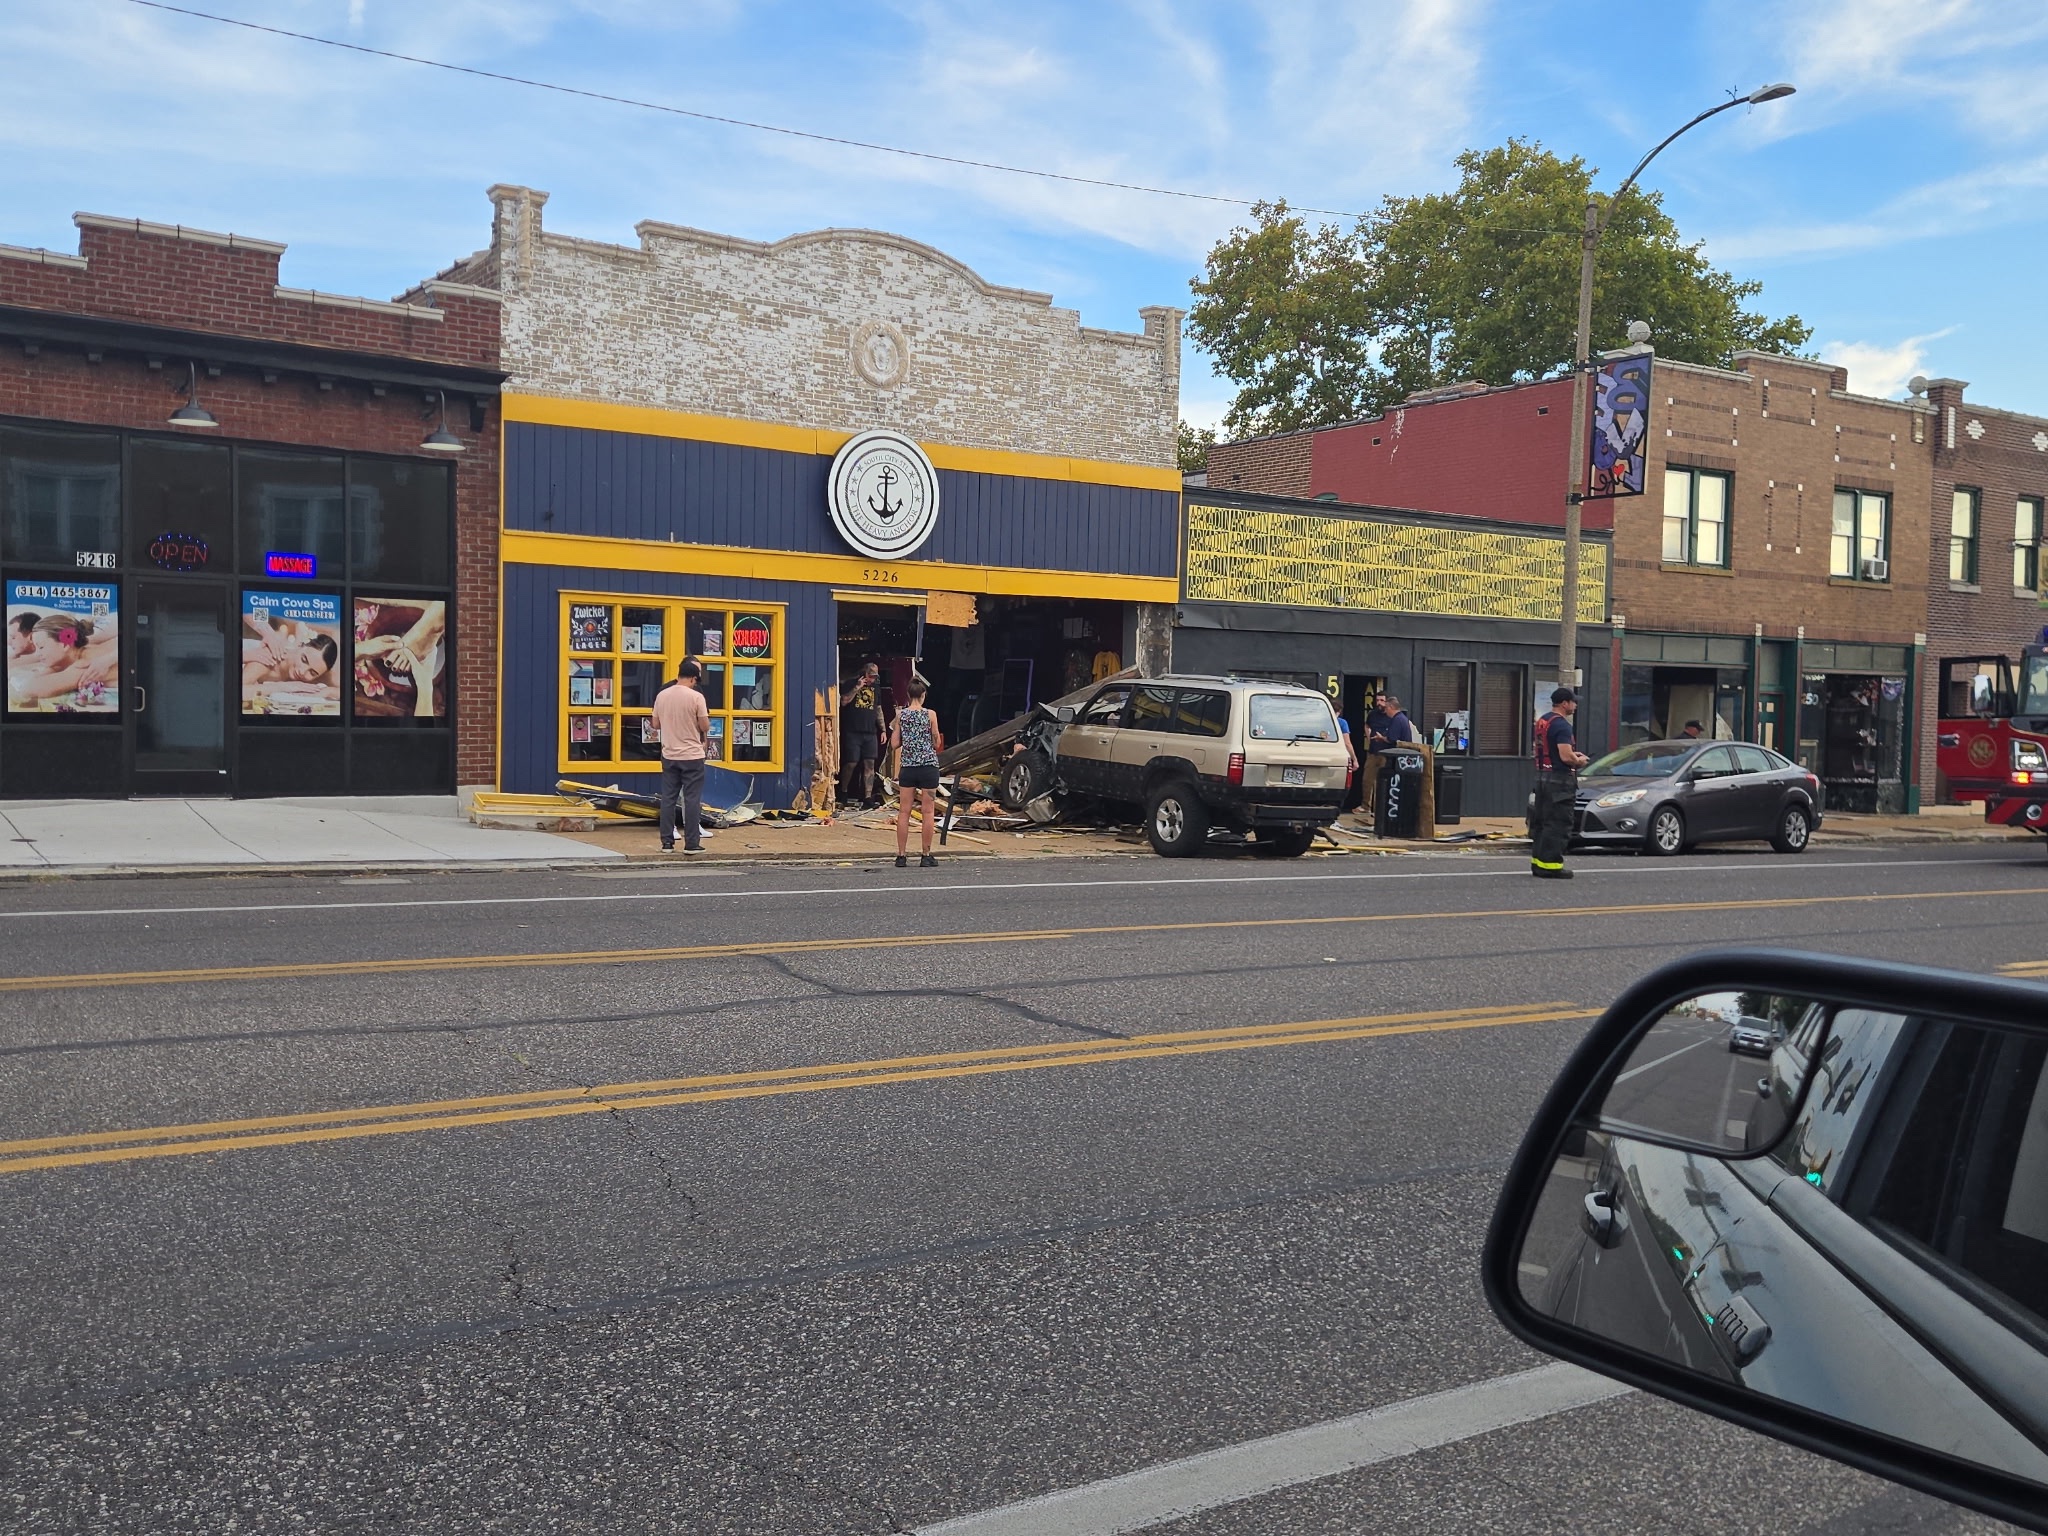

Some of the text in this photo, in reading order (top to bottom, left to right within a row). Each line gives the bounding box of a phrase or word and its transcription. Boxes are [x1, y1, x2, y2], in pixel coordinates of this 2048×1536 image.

[851, 502, 919, 538] THE HEAVY ANCHOR
[1190, 506, 1229, 532] ARKADIN
[1230, 510, 1269, 535] ARKADIN
[1270, 514, 1307, 539] ARKADIN
[1308, 517, 1344, 542] ARKADIN
[1345, 521, 1381, 545] ARKADIN
[1382, 525, 1415, 548] ARKADIN
[150, 542, 208, 563] OPEN
[1189, 530, 1229, 556] ARKADIN
[1230, 533, 1268, 559] ARKADIN
[1269, 536, 1307, 562] ARKADIN
[1308, 540, 1344, 564] ARKADIN
[1345, 543, 1380, 567] ARKADIN
[1381, 546, 1415, 570] ARKADIN
[77, 552, 115, 567] 5218
[268, 556, 313, 574] MASSAGE
[863, 569, 898, 583] 5226
[1189, 554, 1228, 578] ARKADIN
[1229, 557, 1268, 581] ARKADIN
[1269, 560, 1306, 583] ARKADIN
[1307, 563, 1343, 586] ARKADIN
[1344, 565, 1380, 588] ARKADIN
[1381, 568, 1414, 591] ARKADIN
[15, 586, 110, 599] (314) 465-3867
[1188, 576, 1228, 599] ARKADIN
[1229, 579, 1267, 602] ARKADIN
[1268, 582, 1306, 604] ARKADIN
[1344, 587, 1379, 609] ARKADIN
[1380, 589, 1414, 611] ARKADIN
[250, 596, 334, 610] Calm Cove Spa
[574, 606, 605, 618] Zwickel
[576, 641, 607, 650] LAGER
[733, 629, 767, 646] SCHLAFLY
